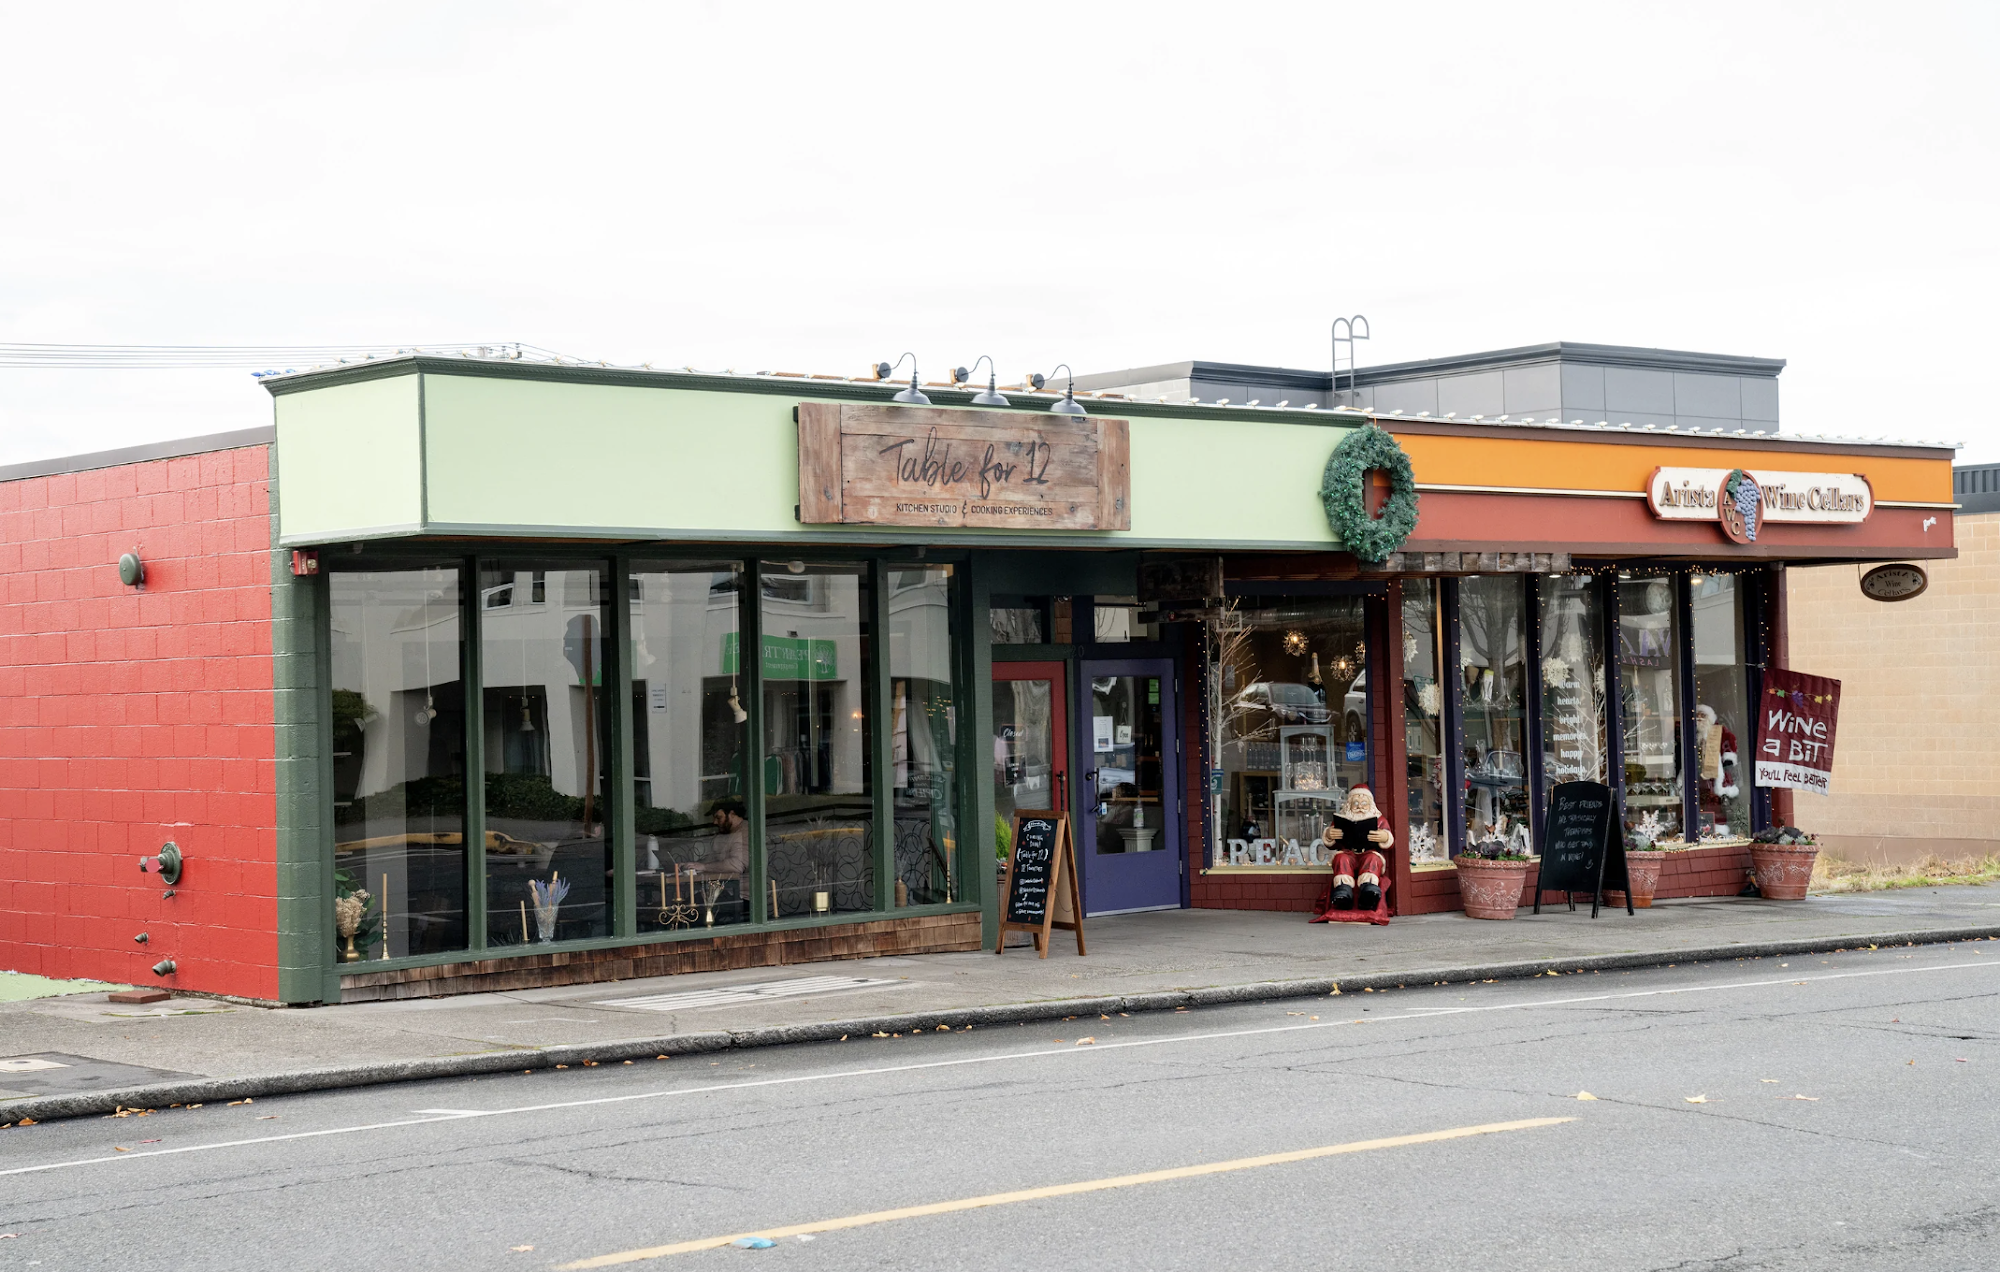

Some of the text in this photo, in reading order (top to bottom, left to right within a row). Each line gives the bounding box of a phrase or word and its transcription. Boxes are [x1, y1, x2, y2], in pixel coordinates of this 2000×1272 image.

[879, 426, 1051, 500] Table for 12
[896, 502, 929, 514] KITCHEN
[930, 504, 957, 515] STUDIO
[971, 505, 1003, 516] COOKING
[1004, 506, 1053, 517] EXPERIENCES
[1659, 480, 1865, 512] Arista Wine Cellars
[1227, 838, 1331, 866] PEAC
